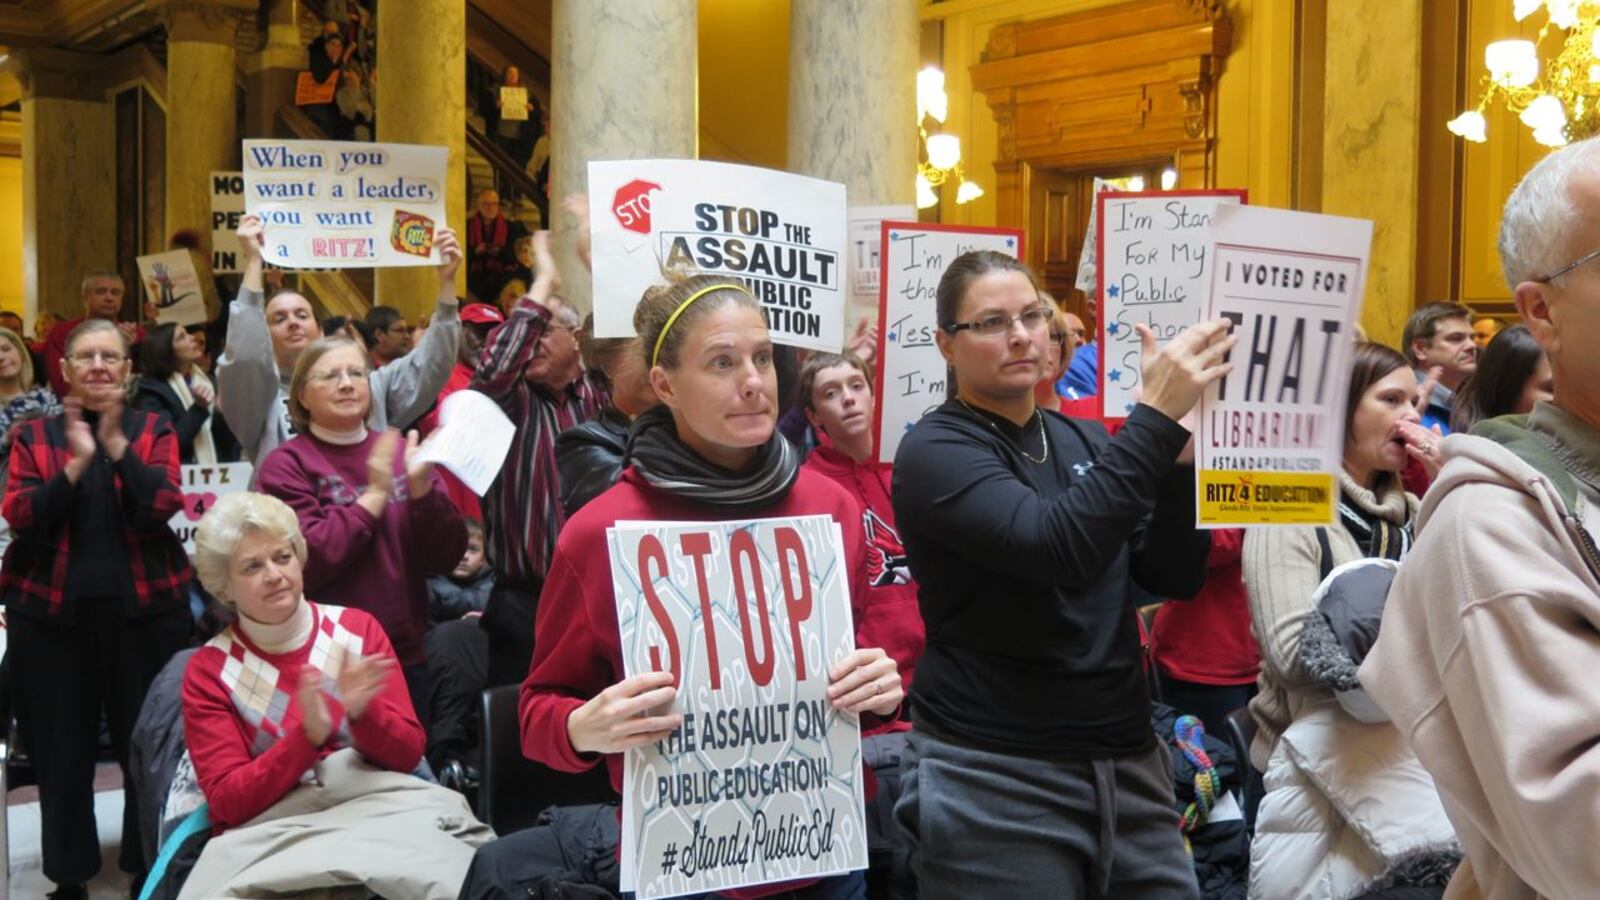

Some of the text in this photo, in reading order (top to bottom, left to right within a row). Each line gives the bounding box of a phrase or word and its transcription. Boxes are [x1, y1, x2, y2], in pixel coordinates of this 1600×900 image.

[251, 146, 382, 172] When you
[256, 176, 434, 200] want a leader,
[259, 210, 373, 228] you want
[694, 203, 811, 245] STOP THE
[1113, 201, 1152, 232] I'm
[213, 251, 236, 270] IN
[278, 238, 375, 257] a RITZ!
[666, 236, 835, 286] ASSAULT
[897, 234, 942, 271] I'm
[1171, 243, 1206, 279] My
[1121, 273, 1187, 304] Public
[1225, 262, 1347, 293] I VOTED FOR
[740, 277, 812, 310] UBLIC
[892, 314, 936, 343] Tes
[1219, 311, 1340, 404] THAT
[898, 371, 945, 396] I'm
[193, 499, 206, 516] 4
[1206, 483, 1236, 502] RITZ
[1239, 485, 1250, 501] 4
[637, 527, 813, 691] STOP
[701, 703, 790, 750] ASSAULT
[795, 699, 827, 740] ON
[658, 757, 829, 808] PUBLIC EDUCATION!
